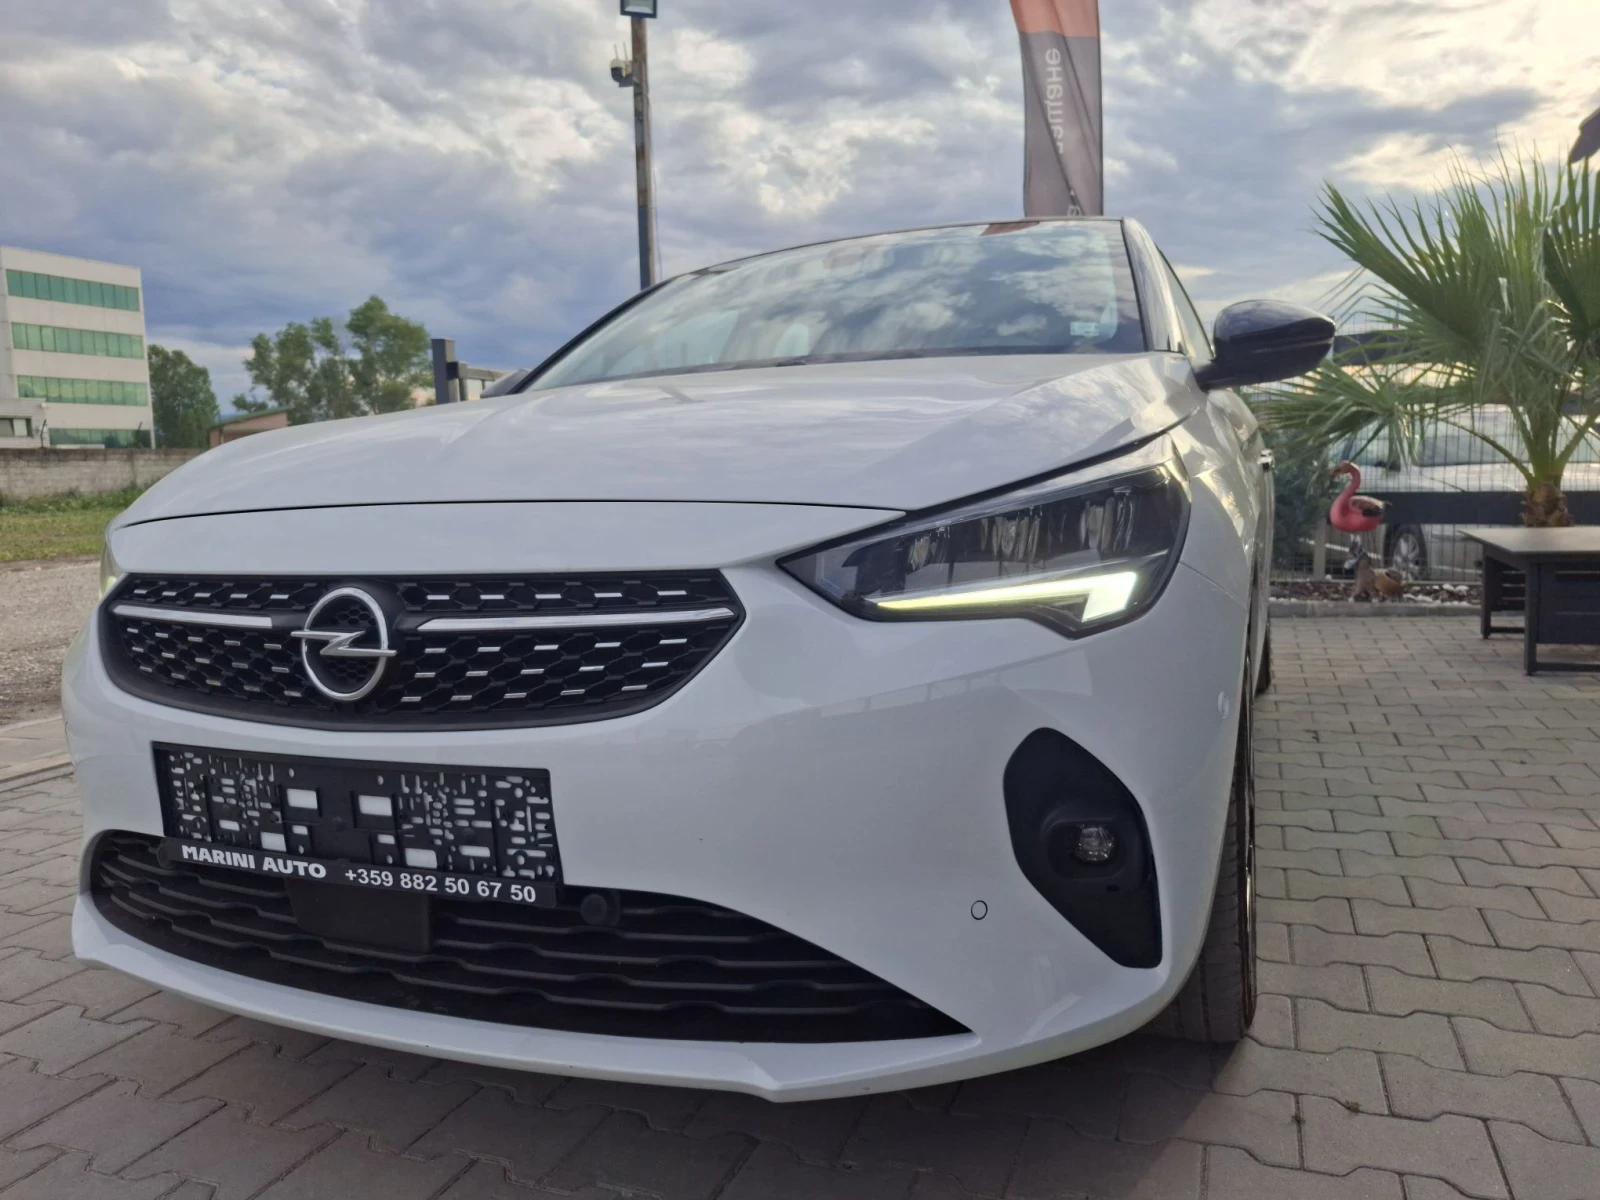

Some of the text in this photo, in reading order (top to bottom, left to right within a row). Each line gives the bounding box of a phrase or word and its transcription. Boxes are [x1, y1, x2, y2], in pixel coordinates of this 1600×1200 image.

[181, 844, 327, 879] MARINI AUTO
[344, 868, 536, 903] +359 882 50 67 50
